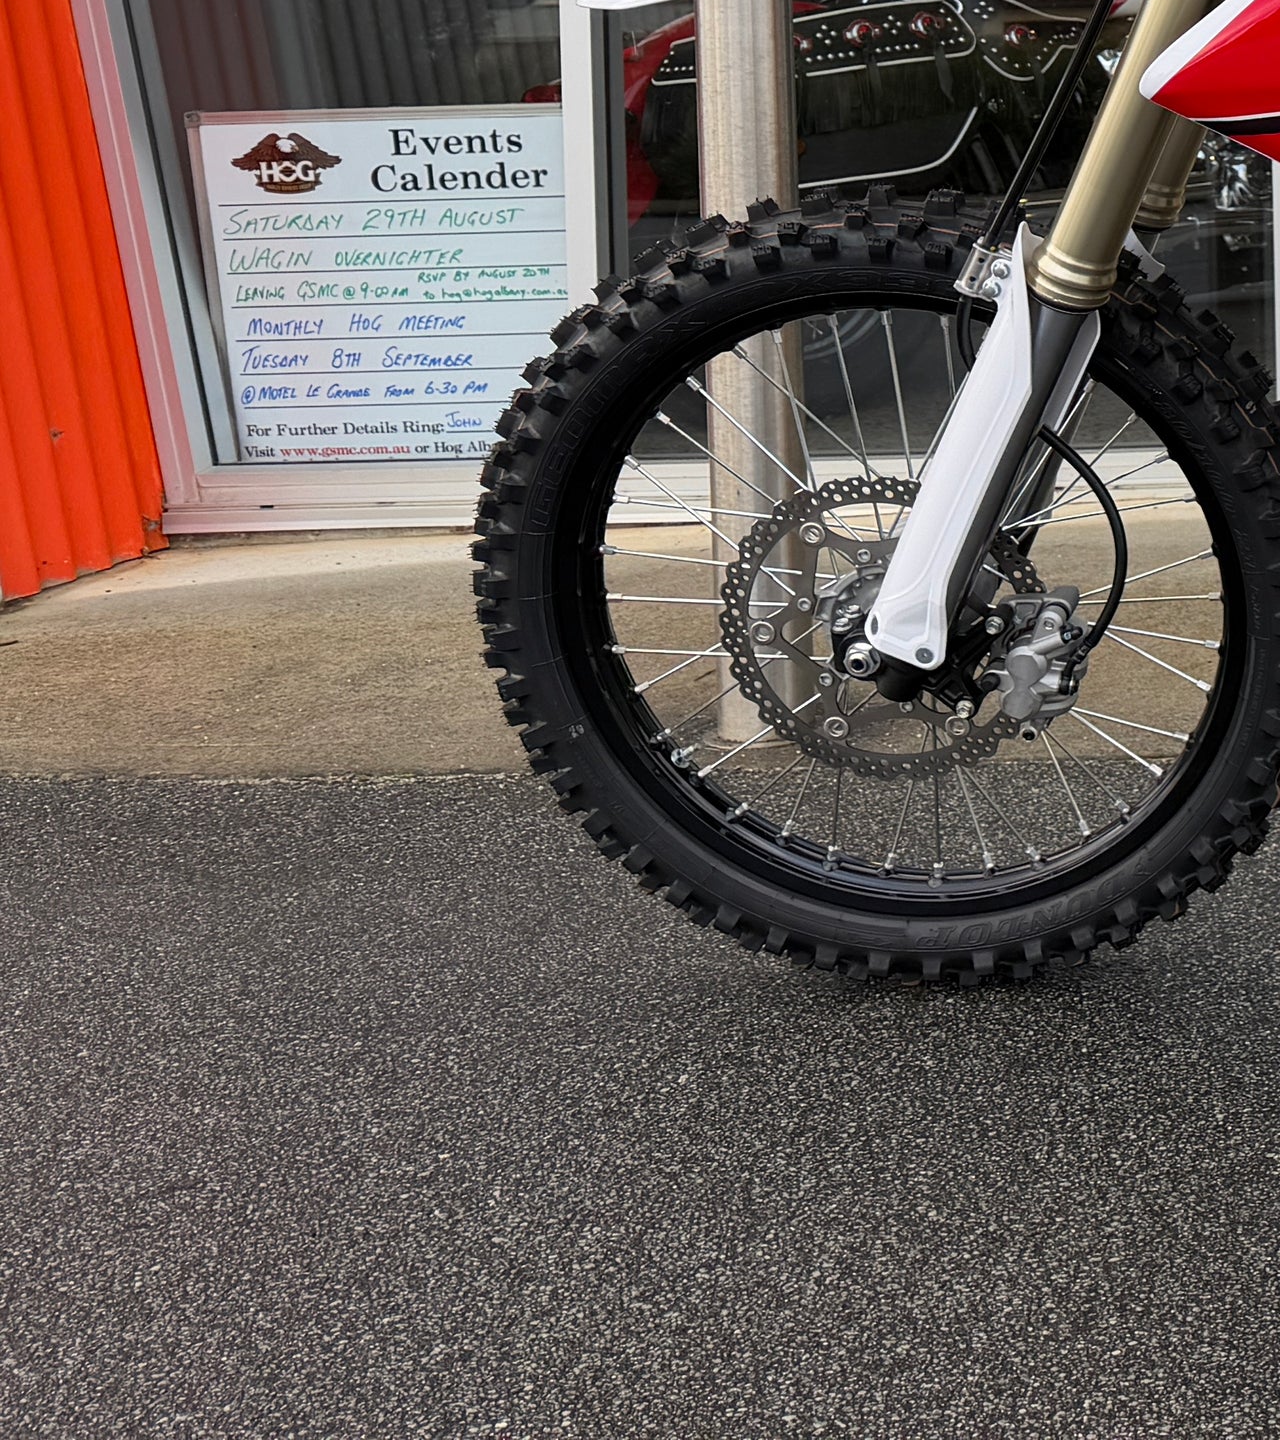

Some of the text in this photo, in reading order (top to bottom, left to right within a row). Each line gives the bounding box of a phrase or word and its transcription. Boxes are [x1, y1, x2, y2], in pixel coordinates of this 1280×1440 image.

[388, 128, 523, 156] Events
[259, 160, 316, 183] HOG
[371, 162, 548, 192] Calender
[223, 207, 525, 235] SATURDAY 29TH AUGUST
[247, 313, 466, 336] MONTHLY HOG MEETING
[242, 345, 473, 372] TUESDAY 8TH SEPTEMBER
[246, 421, 445, 437] For Further Details Ring:
[244, 446, 275, 458] Visit
[279, 444, 411, 458] www.gsmc.com.au
[415, 444, 430, 454] or
[433, 441, 463, 456] Hog
